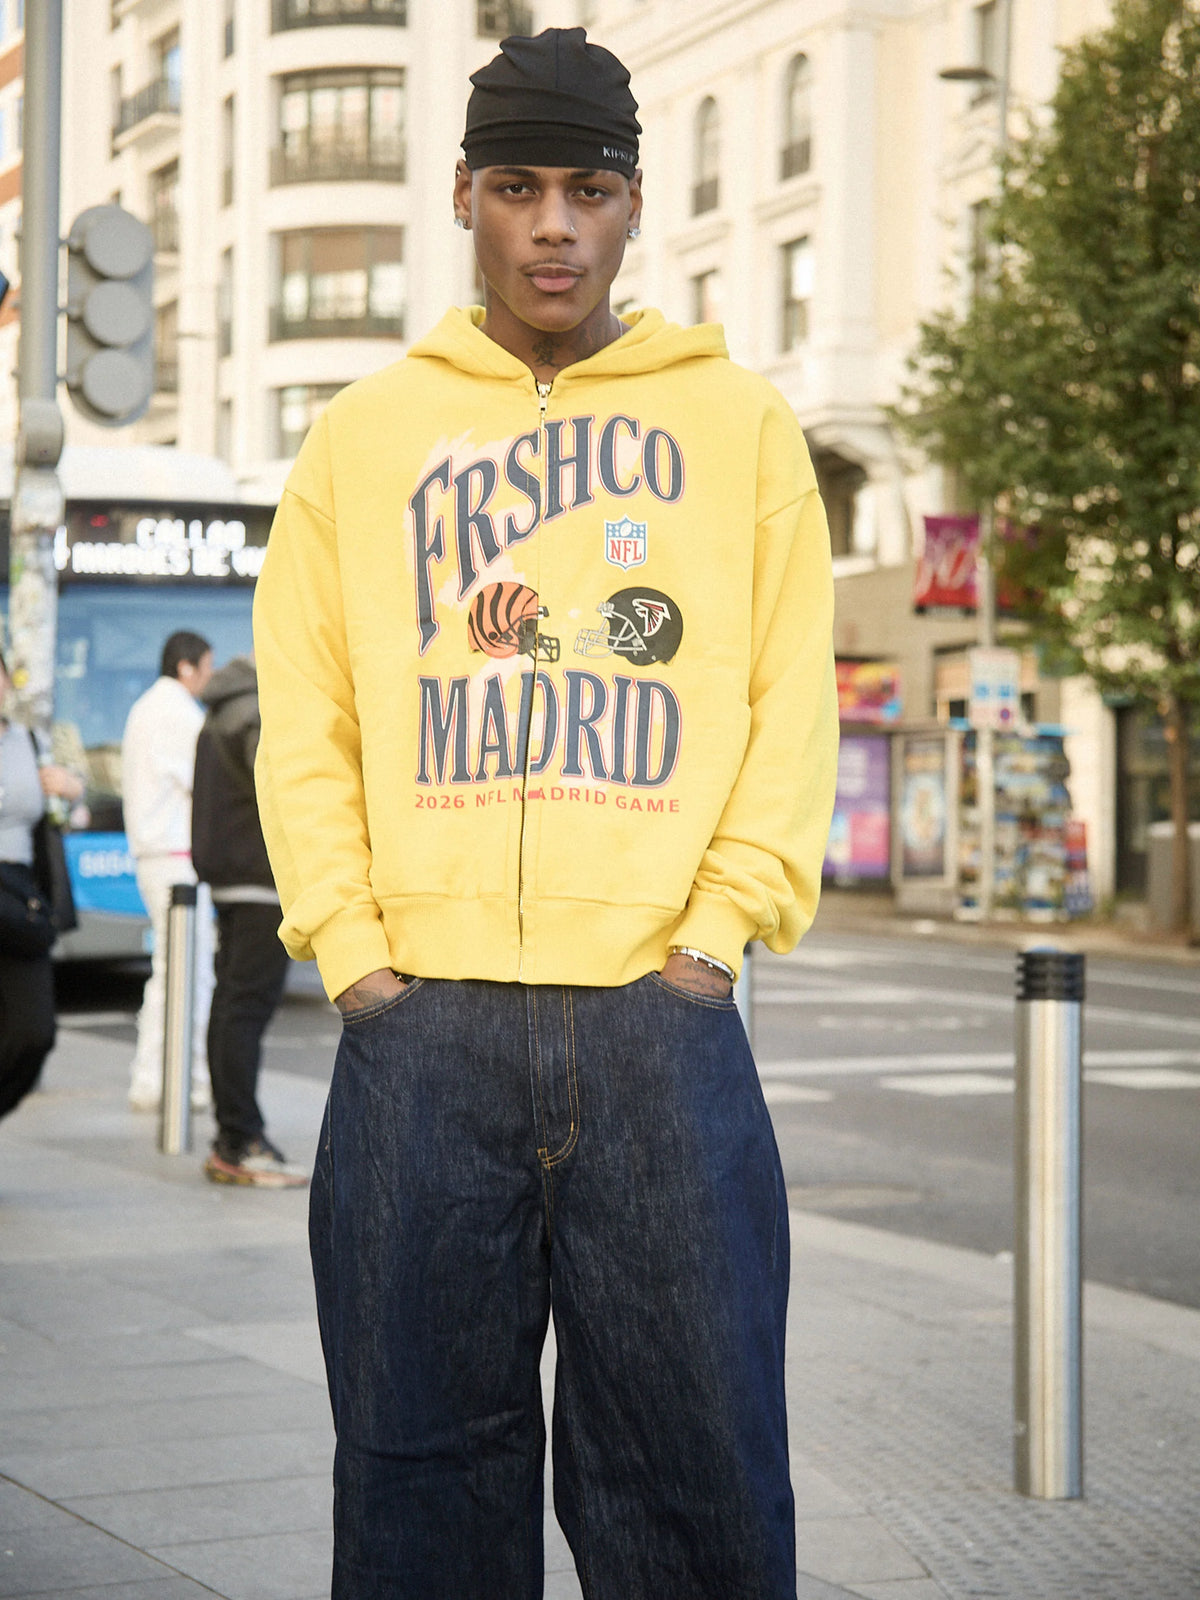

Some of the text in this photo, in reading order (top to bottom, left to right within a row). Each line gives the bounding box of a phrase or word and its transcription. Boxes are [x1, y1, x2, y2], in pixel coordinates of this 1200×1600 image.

[408, 413, 686, 657] FRSHCO
[609, 539, 642, 563] NFL
[416, 670, 681, 788] MADRID
[415, 793, 465, 809] 2026
[476, 789, 507, 808] NFL
[615, 795, 680, 813] GAME
